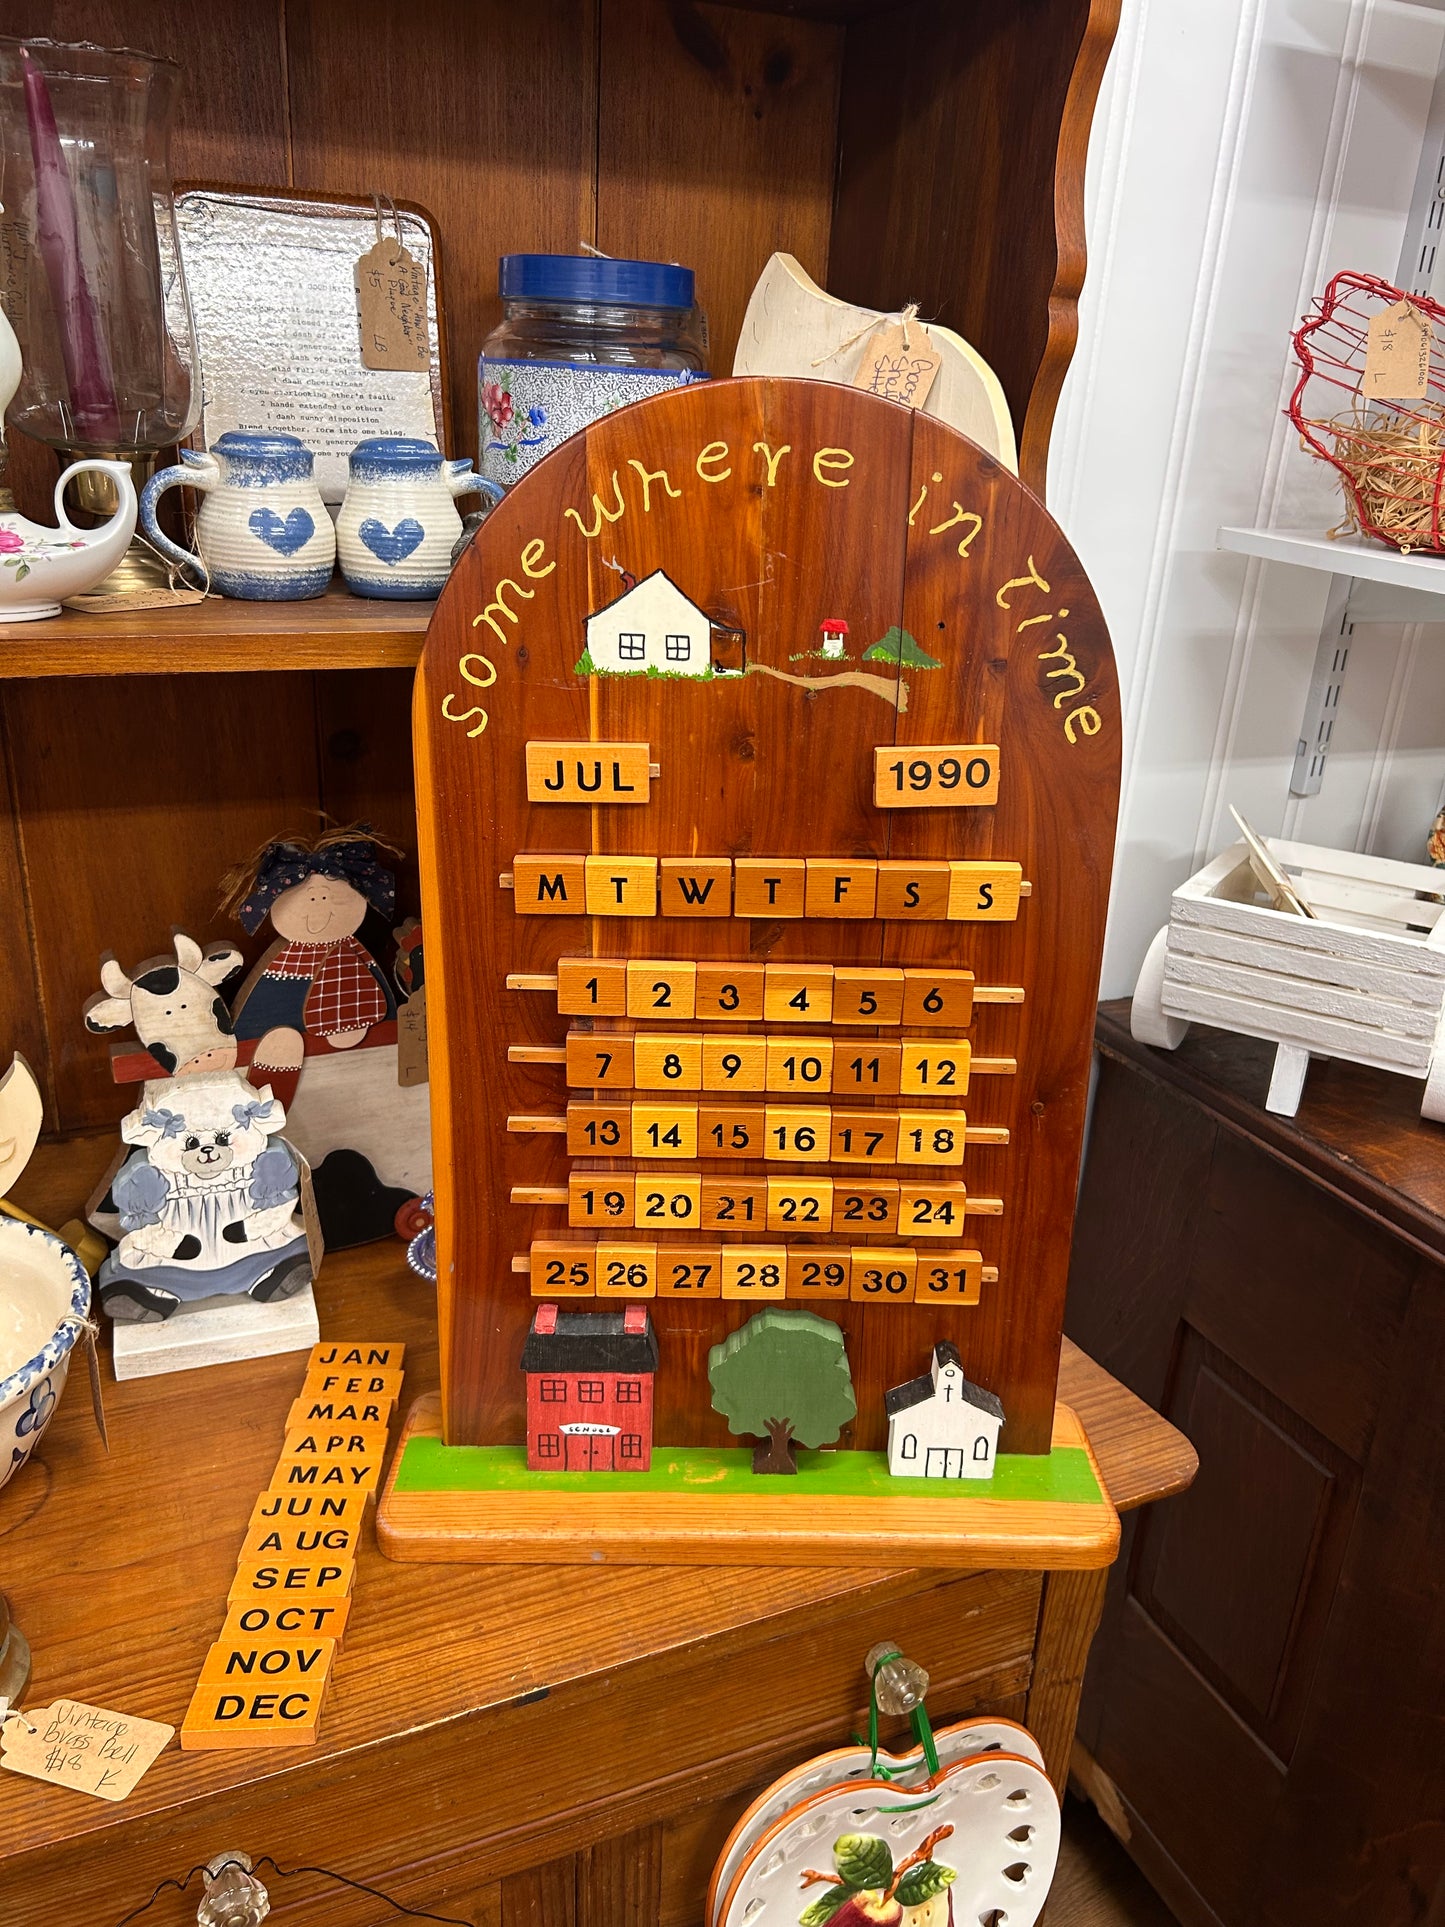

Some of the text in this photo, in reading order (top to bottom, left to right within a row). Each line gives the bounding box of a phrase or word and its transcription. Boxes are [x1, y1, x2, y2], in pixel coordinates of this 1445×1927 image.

[366, 268, 385, 292] $5
[399, 265, 408, 274] A
[411, 266, 423, 304] Vintage
[418, 346, 429, 359] Be
[1378, 329, 1397, 351] $18
[270, 400, 295, 408] hands
[267, 425, 310, 433] together,
[328, 415, 380, 424] disposition
[907, 471, 983, 558] in
[544, 760, 635, 792] JUL
[889, 758, 991, 791] 1990
[537, 874, 993, 910] M T W T F S S
[585, 977, 944, 1015] 1 2 3 4 5 6
[596, 1053, 956, 1085] 7 8 9 10 11 12
[584, 1119, 954, 1156] 13 14 15 16 17 18
[581, 1190, 955, 1225] 19 20 21 22 23 24
[546, 1260, 967, 1294] 25 26 27 28 29 30 31
[319, 1348, 390, 1365] JAN
[322, 1376, 384, 1393] FEB
[307, 1404, 379, 1421] MAR
[295, 1435, 365, 1453] APR
[288, 1466, 370, 1484] MAY
[261, 1498, 347, 1516] JUN
[258, 1529, 349, 1551] AUG
[252, 1567, 342, 1589] SEP
[239, 1607, 335, 1632] OCT
[225, 1649, 322, 1674] NOV
[214, 1693, 310, 1720] DEC
[42, 1721, 140, 1764] Brass Bell
[45, 1745, 83, 1773] $18
[94, 1768, 123, 1792] K
